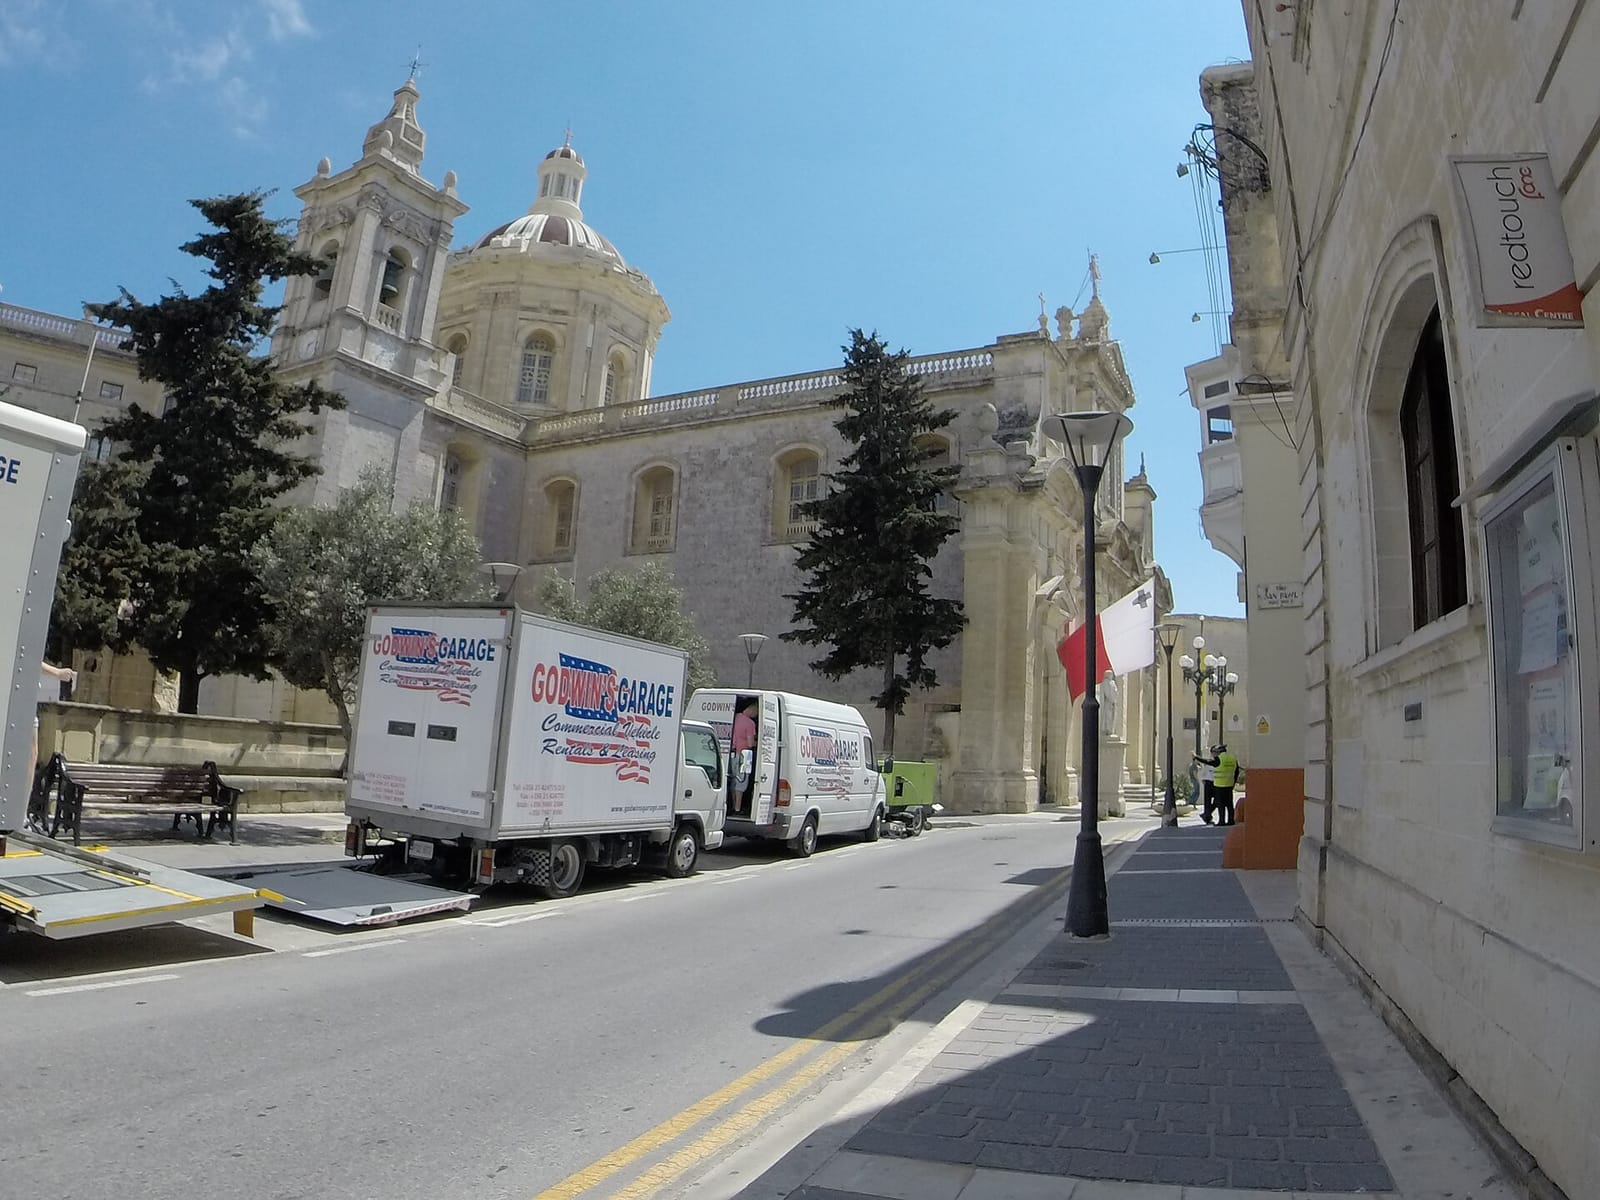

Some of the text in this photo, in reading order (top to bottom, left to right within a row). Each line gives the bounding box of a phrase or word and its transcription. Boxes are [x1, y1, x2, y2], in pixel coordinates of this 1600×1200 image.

[1486, 166, 1535, 289] redtouch
[373, 634, 496, 662] GODWIN'S GARAGE
[379, 659, 483, 678] Commercial Vehicle
[379, 673, 418, 686] Rentals
[434, 679, 478, 693] Leasing
[531, 662, 675, 718] GODWIN'S GARAGE
[541, 712, 661, 741] Commercial Vehicle
[541, 738, 657, 764] Rentals & Leasing
[834, 739, 859, 761] GARAGE
